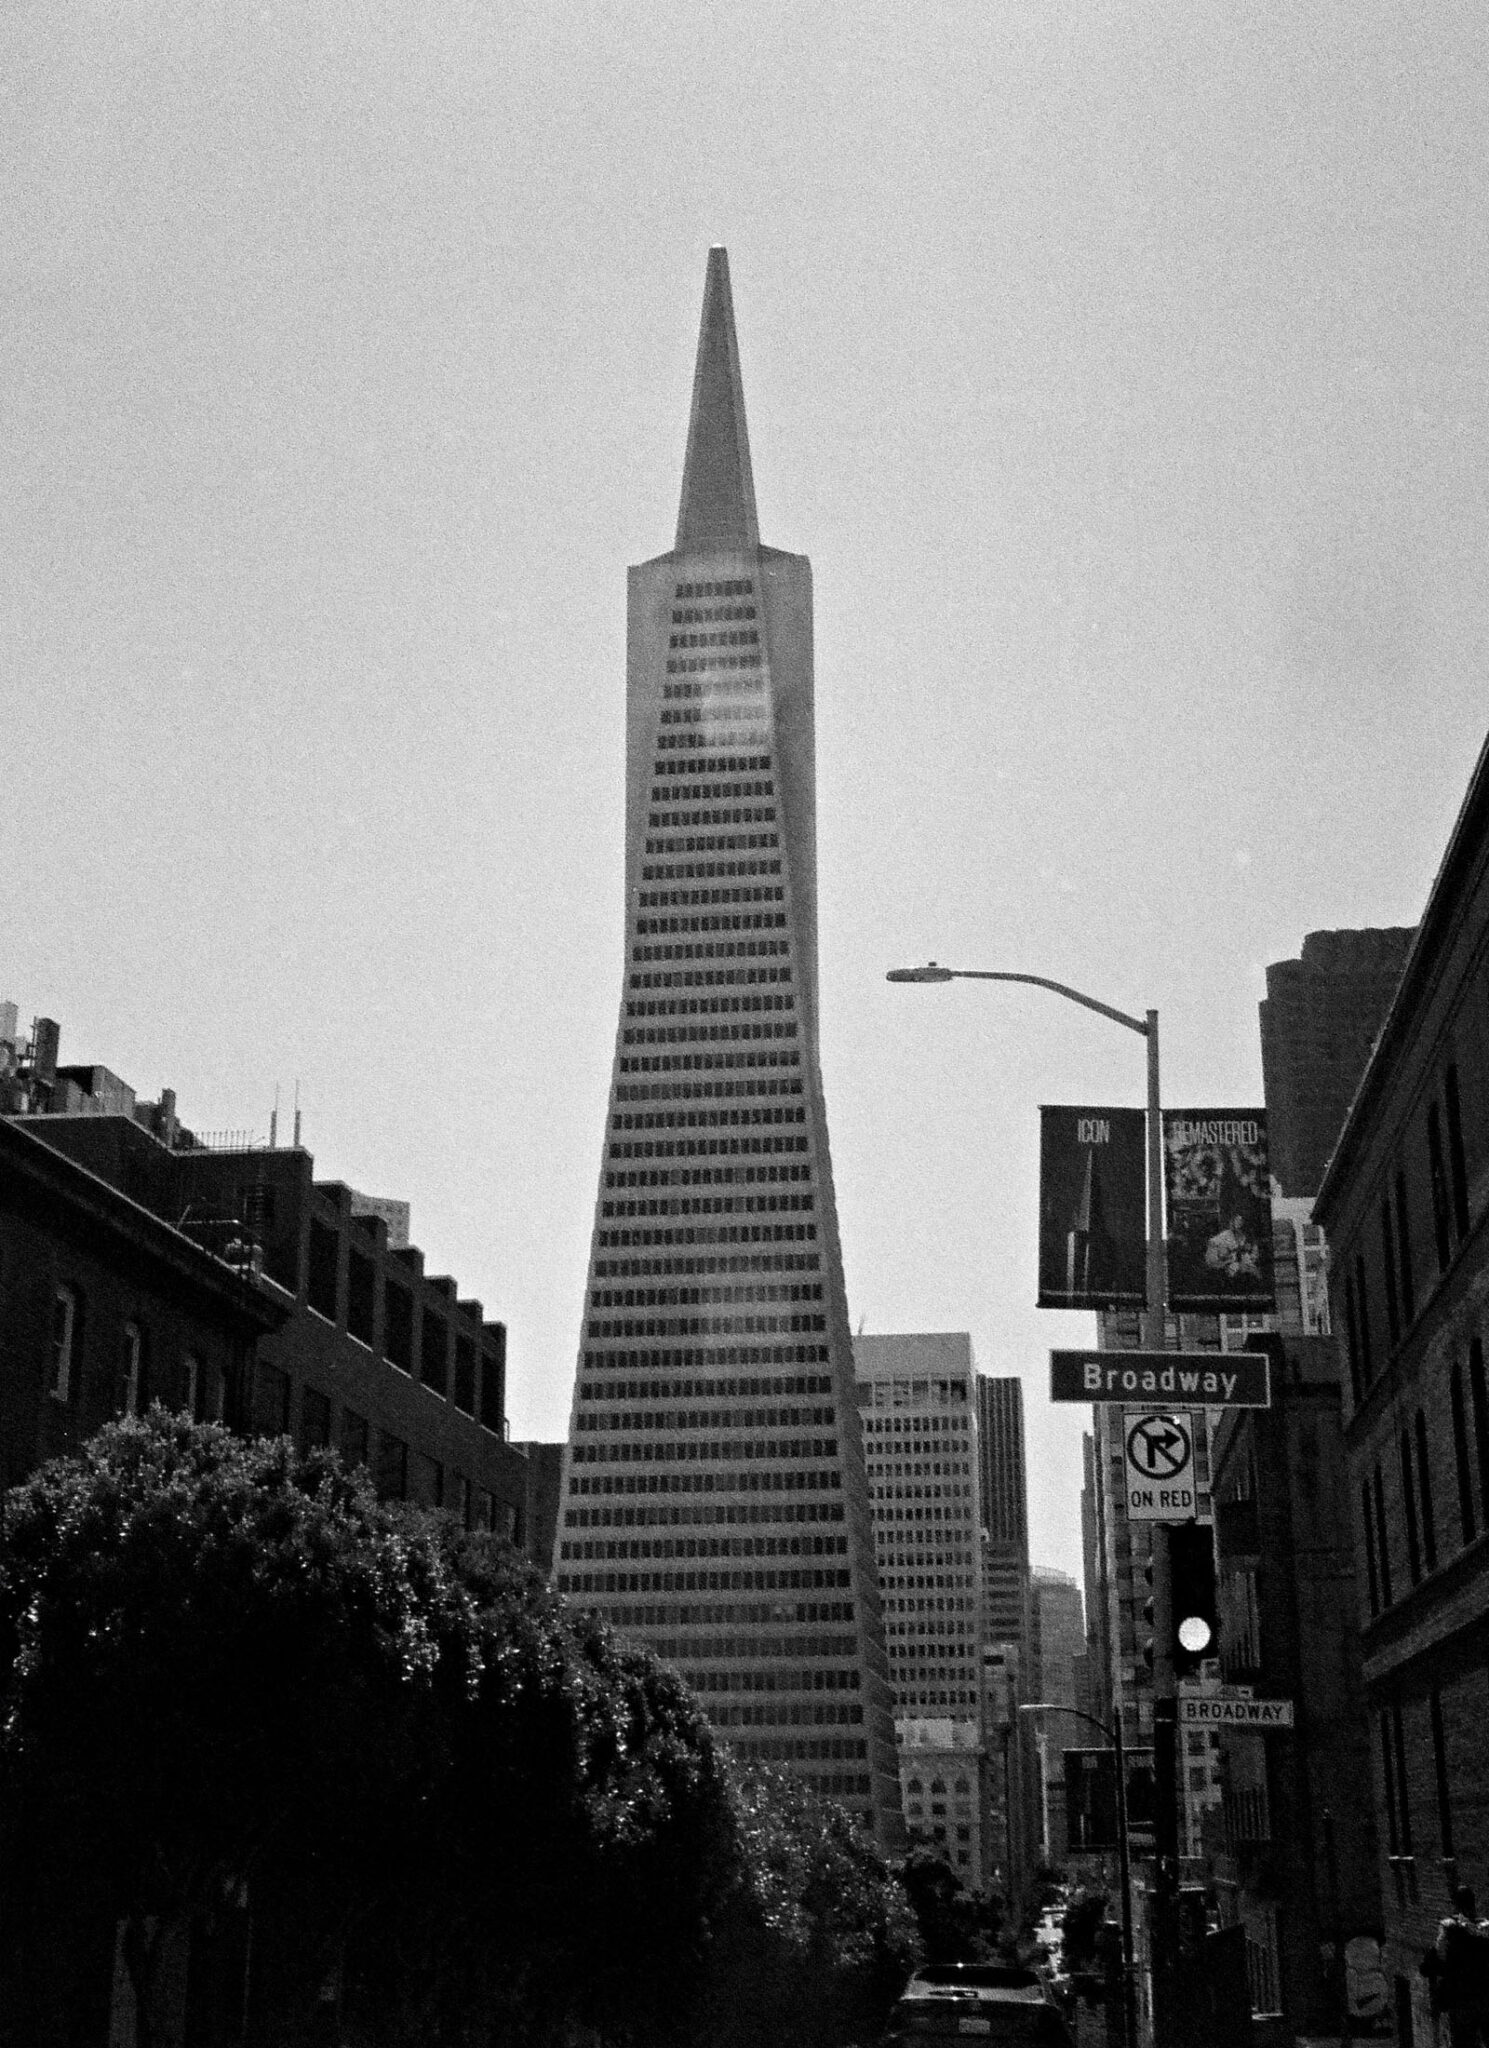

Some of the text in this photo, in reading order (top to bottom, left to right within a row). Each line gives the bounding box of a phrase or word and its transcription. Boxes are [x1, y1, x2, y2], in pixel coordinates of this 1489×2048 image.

[1077, 1118, 1110, 1144] ICON
[1171, 1120, 1259, 1145] REMASTERED
[1083, 1362, 1237, 1399] Broadway
[1130, 1490, 1192, 1508] ON RED
[1186, 1702, 1283, 1720] BROADWAY
